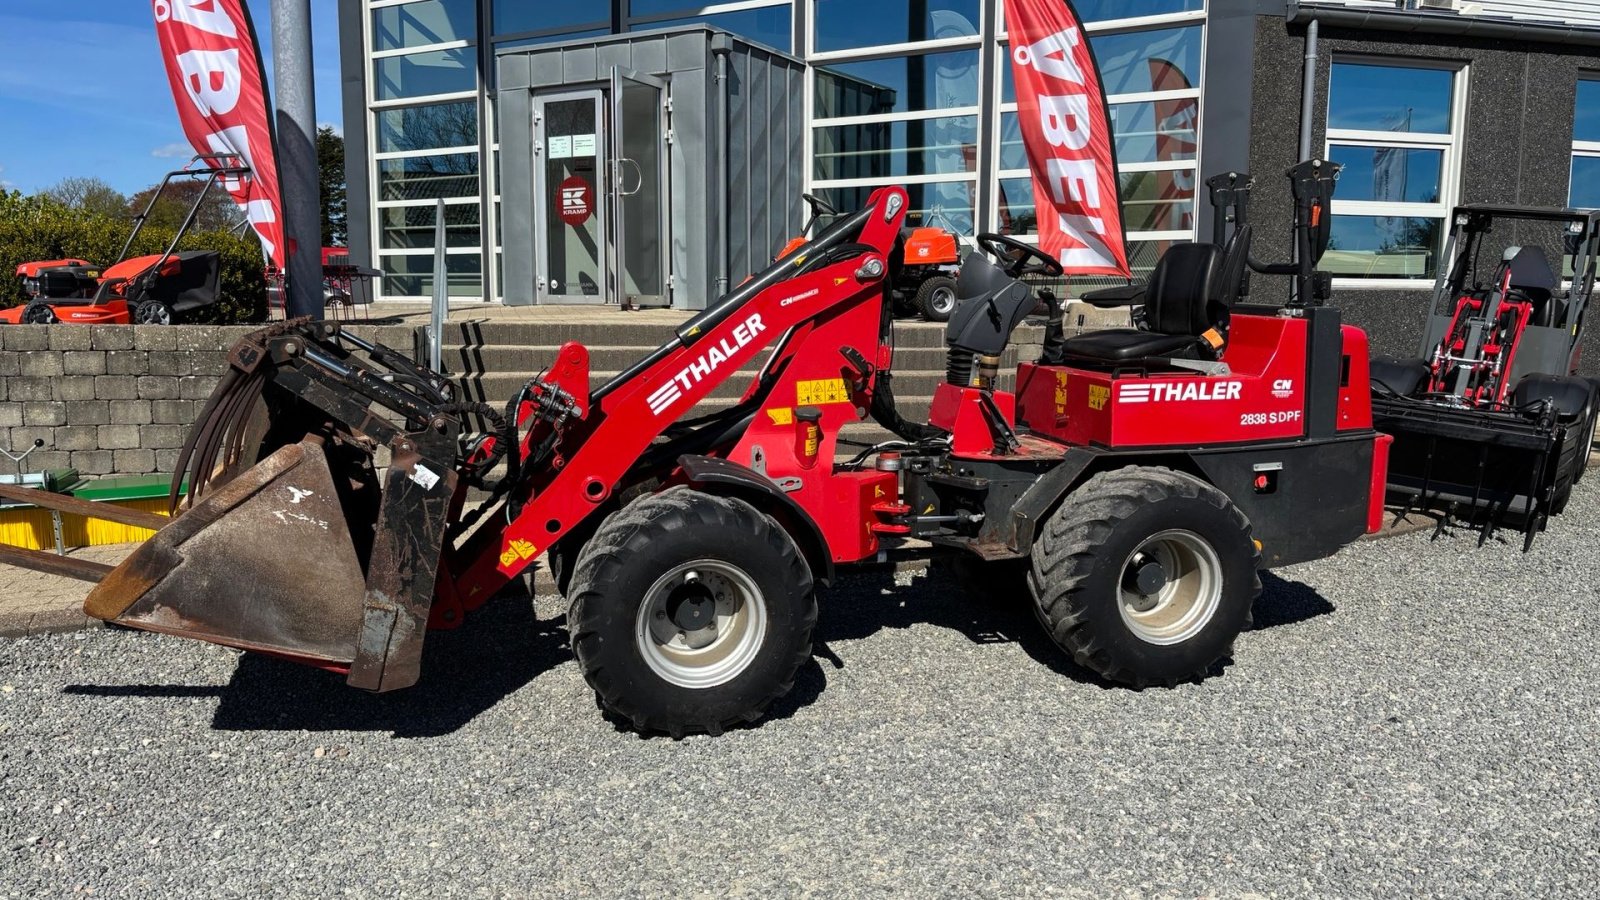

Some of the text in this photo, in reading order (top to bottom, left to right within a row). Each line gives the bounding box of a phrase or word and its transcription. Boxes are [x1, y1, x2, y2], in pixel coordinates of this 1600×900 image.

[780, 297, 793, 307] CN
[674, 313, 767, 391] THALER
[1151, 381, 1242, 402] THALER
[1273, 379, 1293, 390] CN
[1240, 412, 1267, 426] 2838
